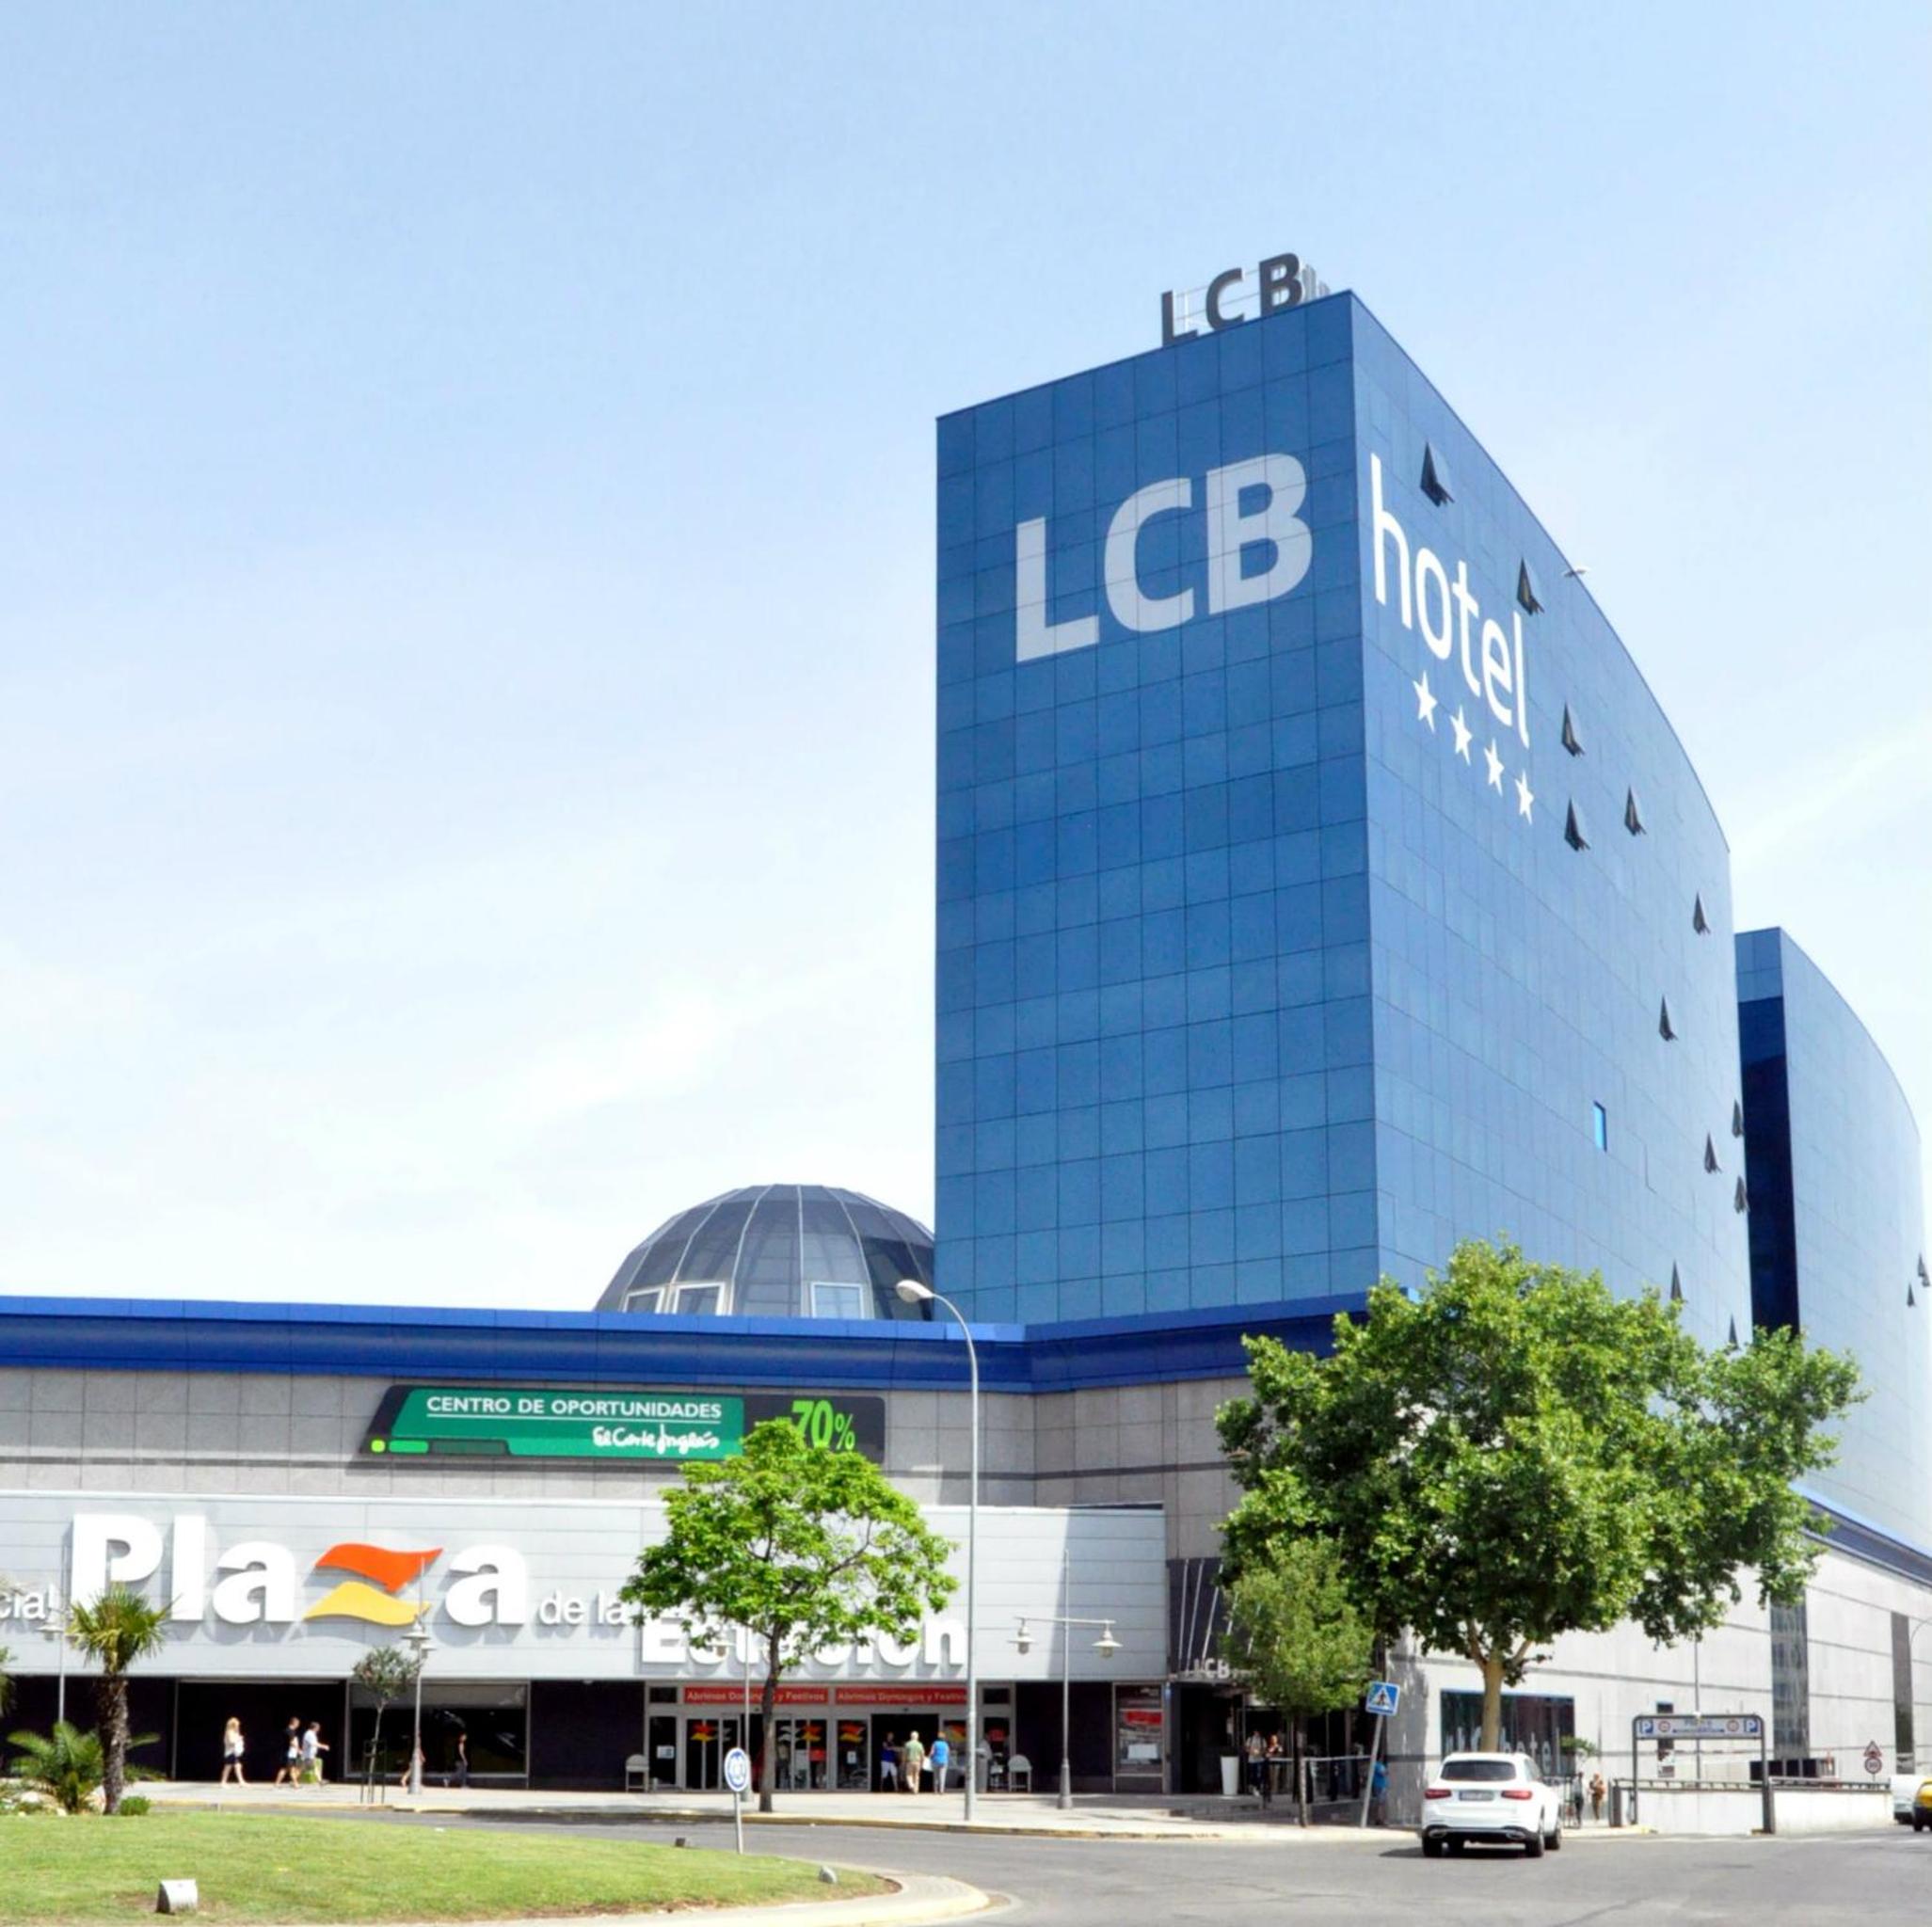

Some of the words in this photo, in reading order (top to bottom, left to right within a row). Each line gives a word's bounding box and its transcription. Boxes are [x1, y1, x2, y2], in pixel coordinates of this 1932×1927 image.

[1161, 252, 1302, 347] LCB
[1015, 453, 1314, 663] LCB
[1370, 453, 1530, 750] hotel
[426, 1396, 511, 1413] CENTRO
[518, 1398, 545, 1413] DE
[551, 1399, 722, 1419] OPORTUNIDADES
[592, 1425, 612, 1446] El
[612, 1426, 656, 1448] Corte
[792, 1399, 855, 1450] 70%
[71, 1513, 527, 1626] Plaza
[539, 1589, 583, 1625] de
[598, 1589, 629, 1625] la
